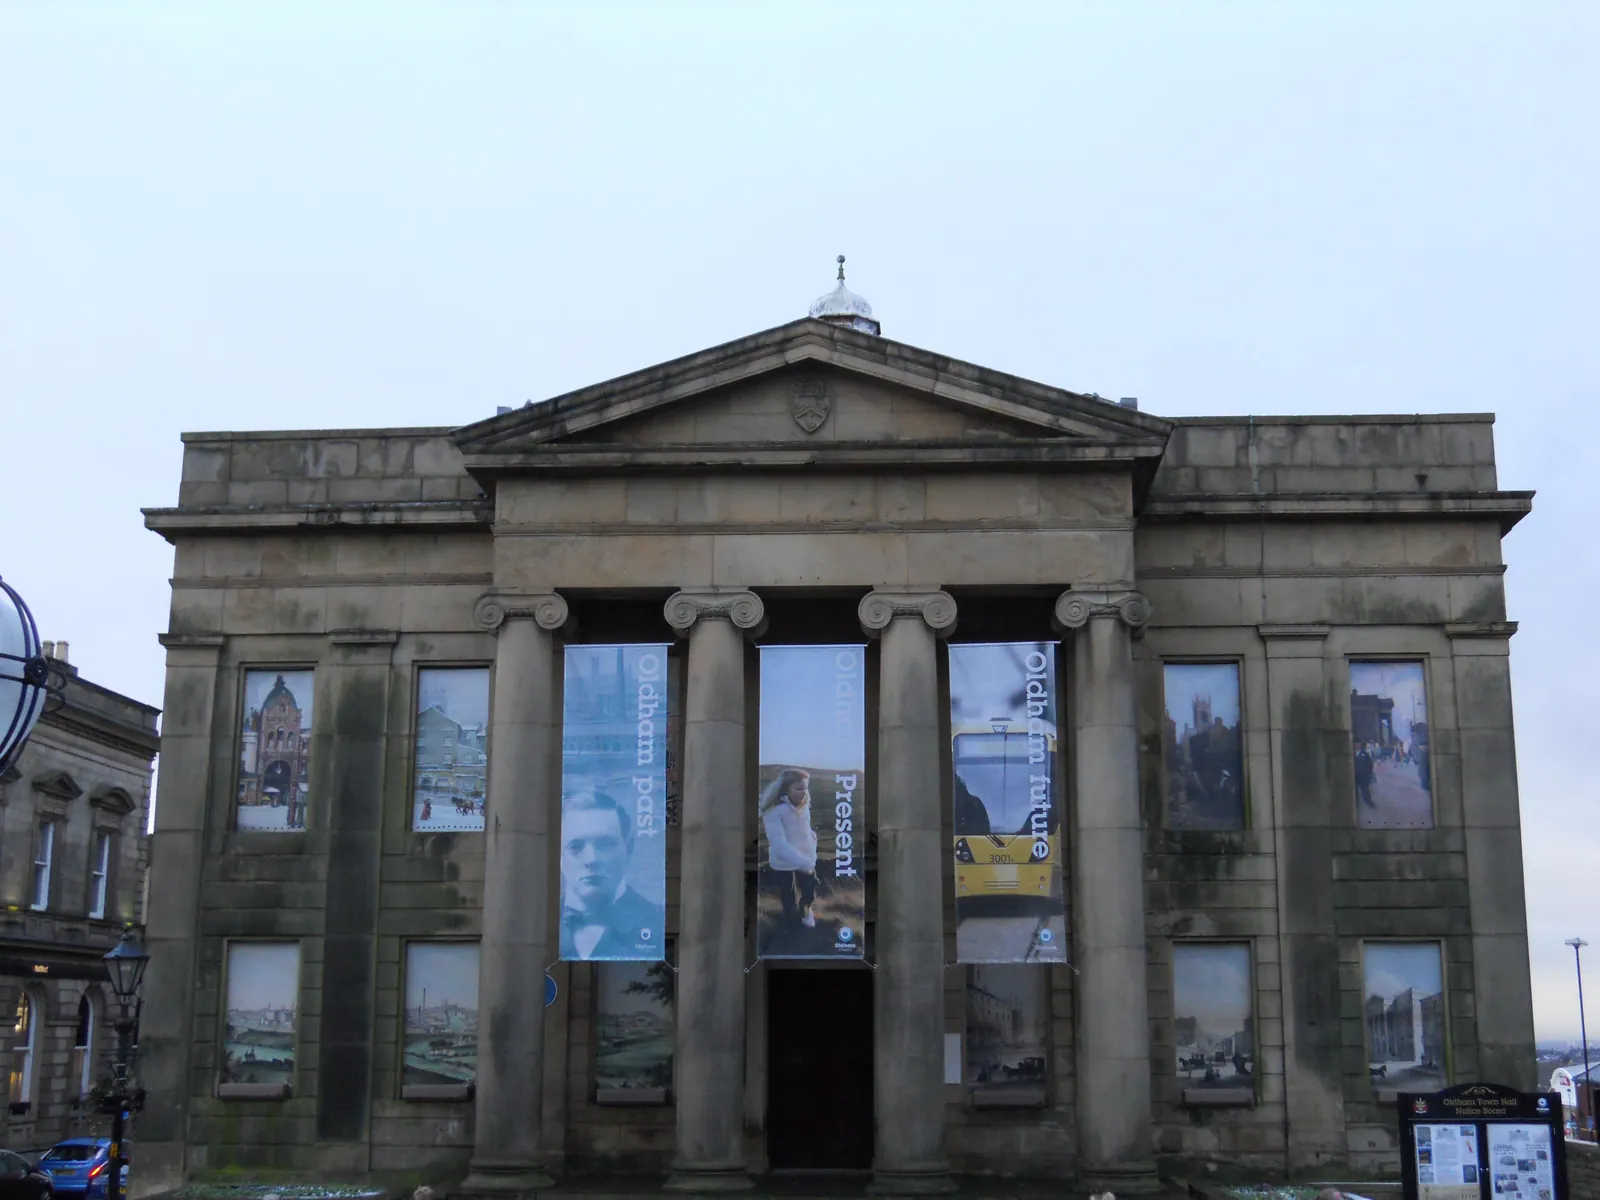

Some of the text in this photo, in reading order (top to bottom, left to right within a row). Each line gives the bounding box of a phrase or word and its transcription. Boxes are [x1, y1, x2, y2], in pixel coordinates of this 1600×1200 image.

[632, 653, 659, 838] Oldham past
[1025, 650, 1051, 860] Oldham future
[835, 774, 857, 878] Present
[1443, 1098, 1475, 1106] Oldham
[1456, 1107, 1506, 1115] Notice Board
